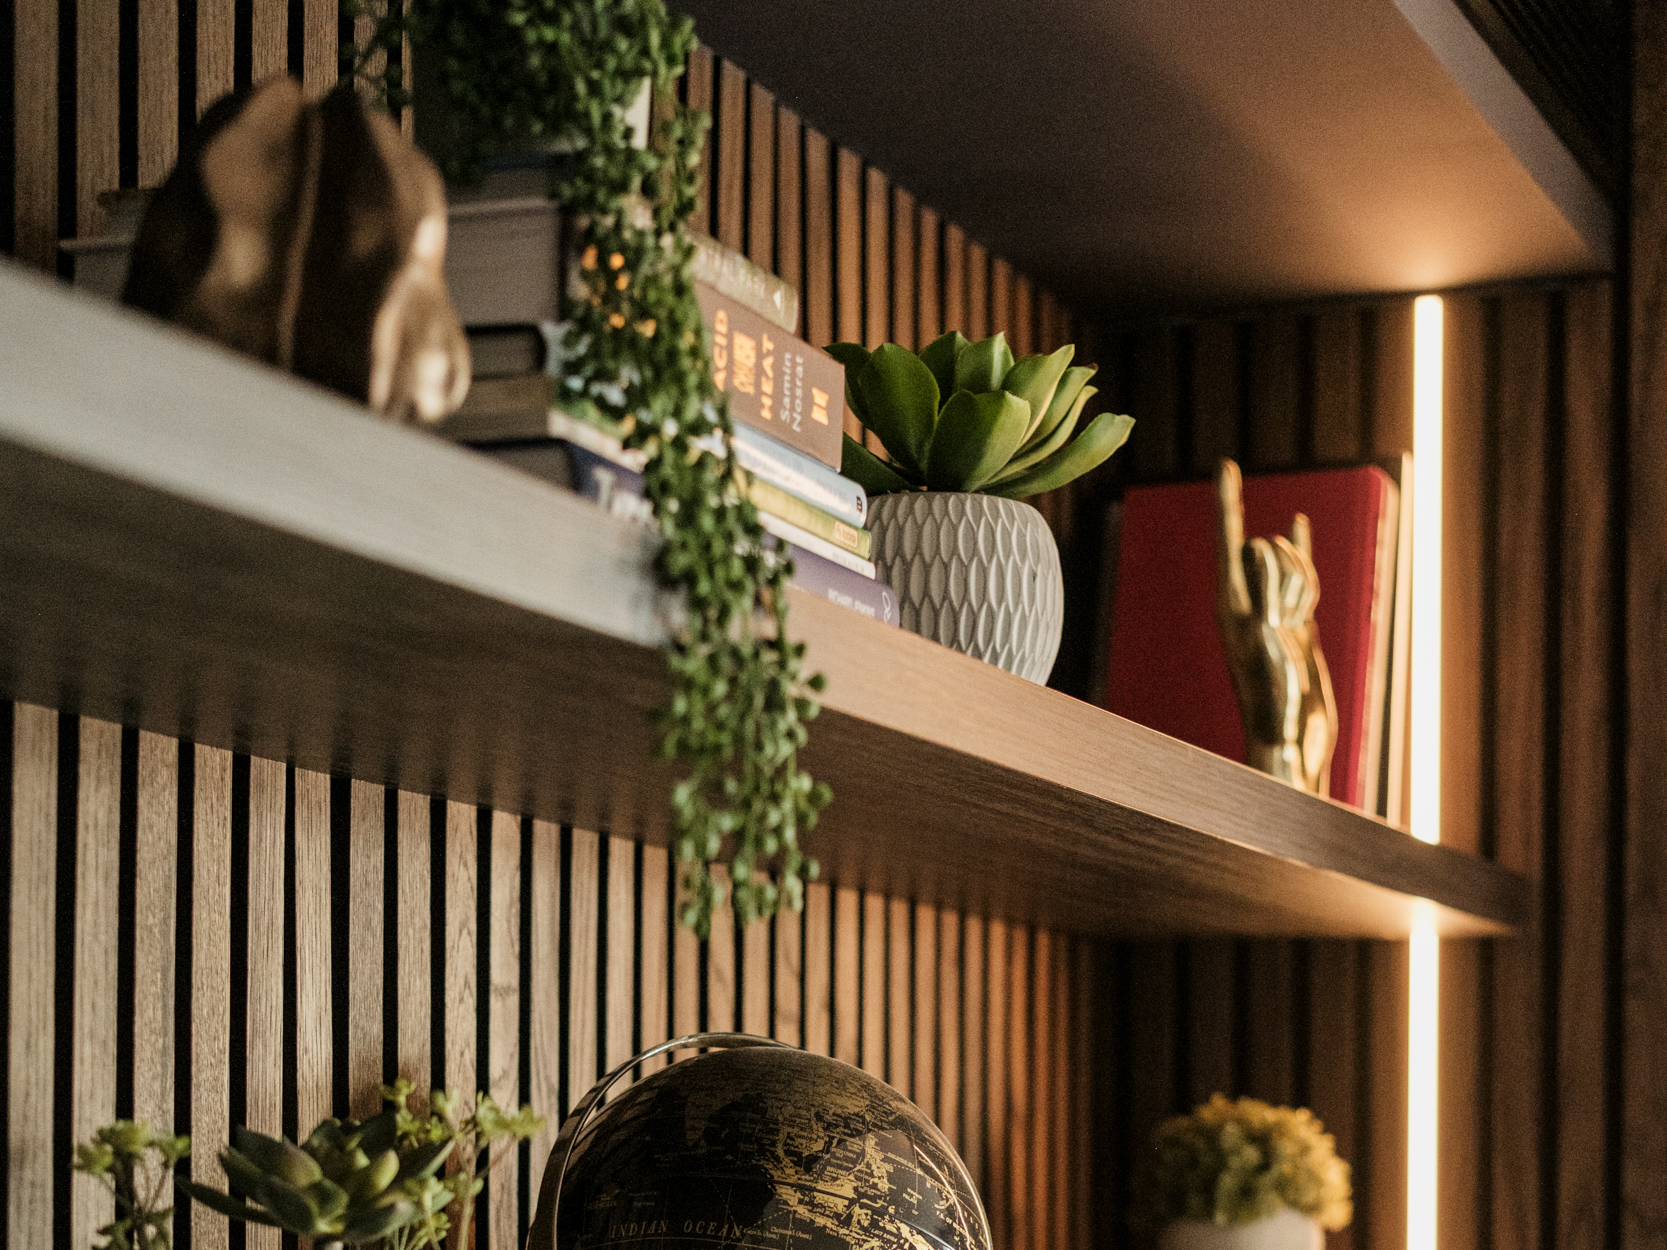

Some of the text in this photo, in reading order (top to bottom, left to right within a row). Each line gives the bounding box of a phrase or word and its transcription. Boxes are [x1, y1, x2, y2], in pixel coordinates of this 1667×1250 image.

[713, 309, 728, 392] ACID
[760, 333, 774, 421] HEAT
[780, 352, 791, 423] Samin
[792, 355, 804, 433] Nosrat
[610, 1220, 743, 1239] INDIAN OCEAN
